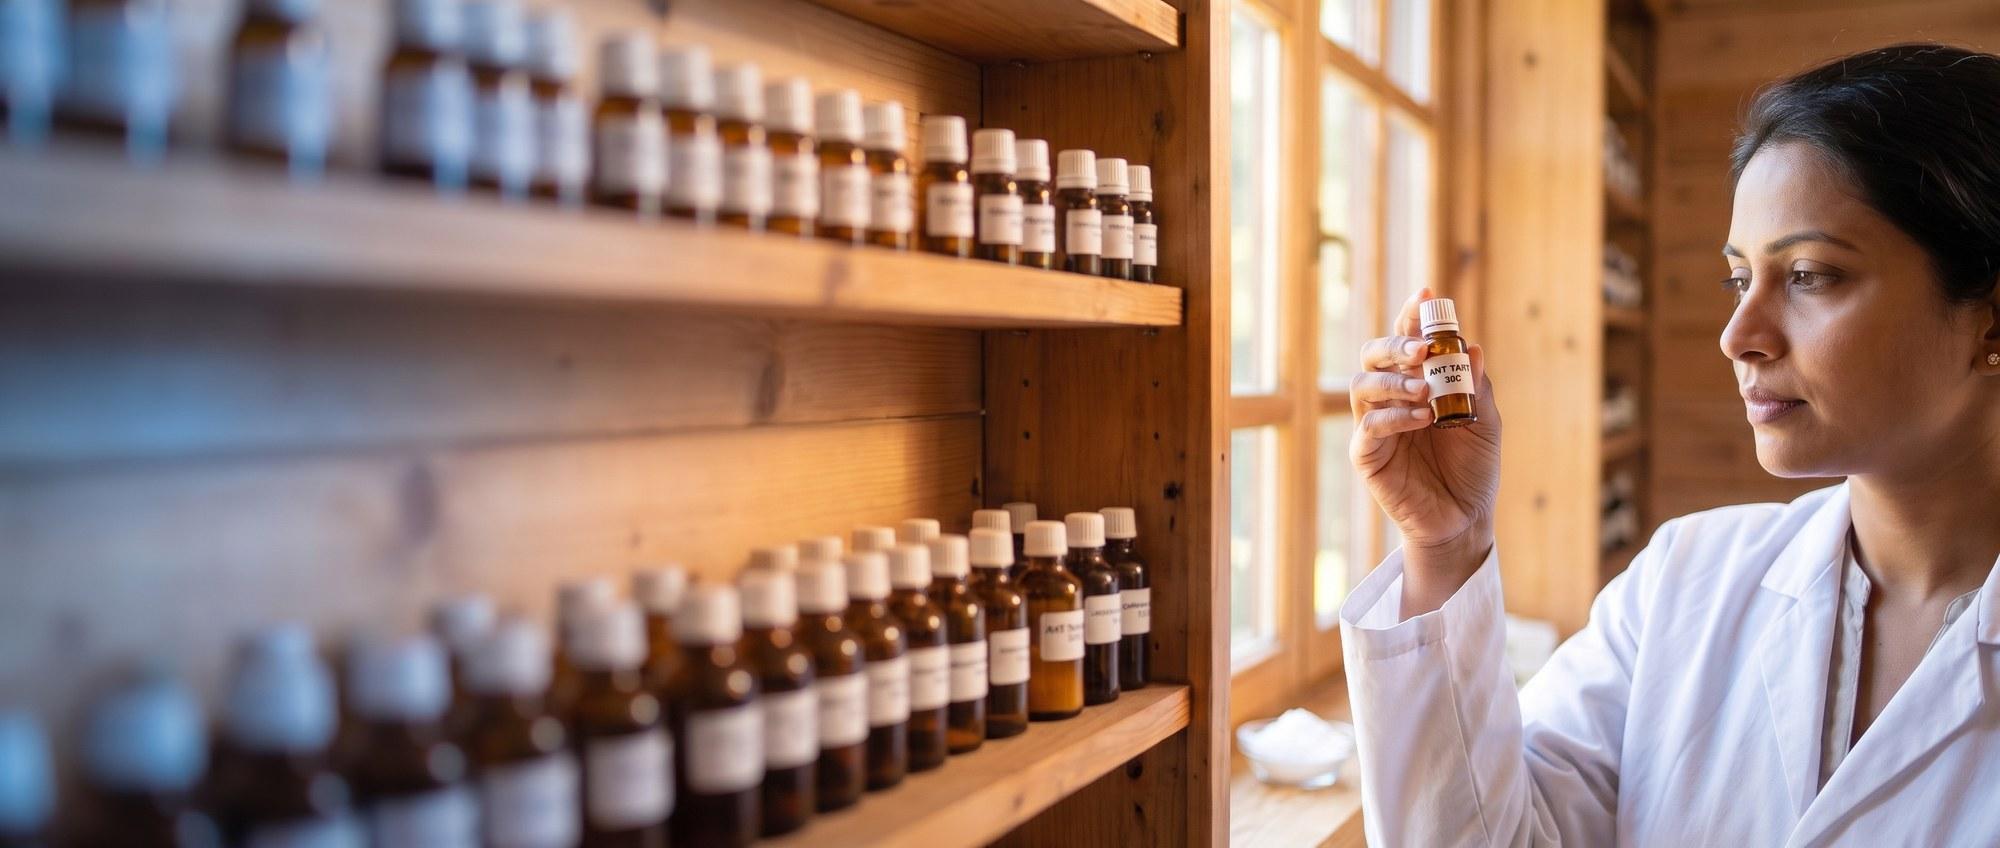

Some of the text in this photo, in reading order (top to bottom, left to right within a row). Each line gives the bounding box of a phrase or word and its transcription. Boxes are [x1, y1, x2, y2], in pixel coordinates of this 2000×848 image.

[1430, 364, 1469, 376] ANT TART
[1444, 375, 1461, 383] 30C
